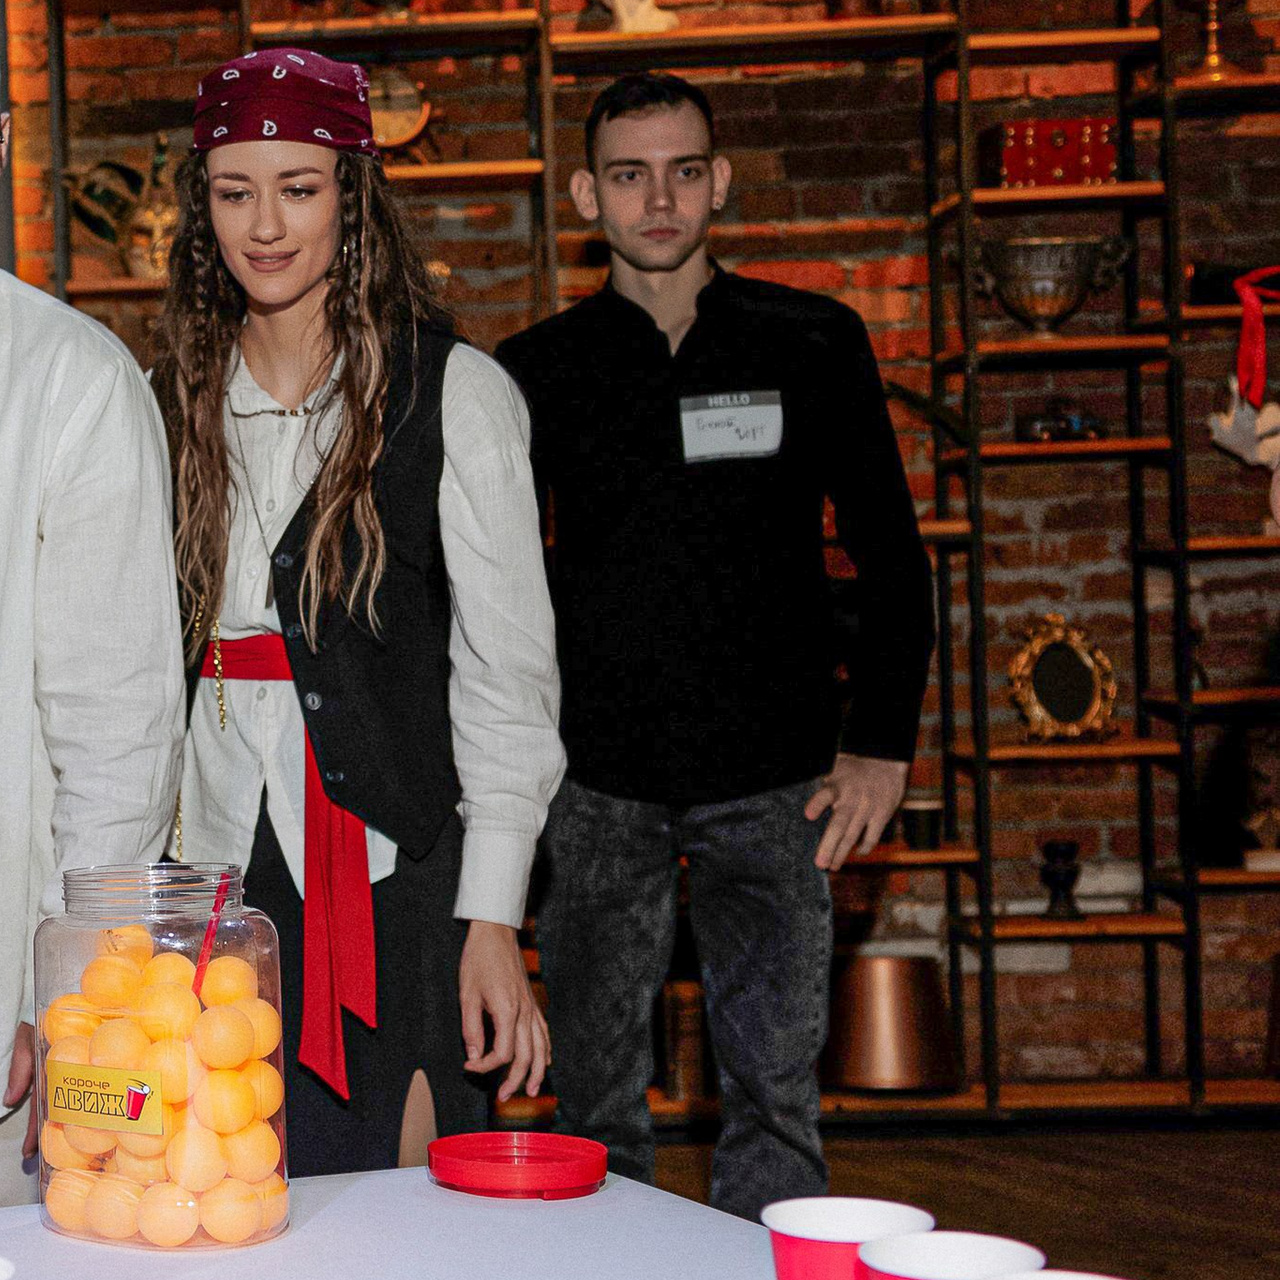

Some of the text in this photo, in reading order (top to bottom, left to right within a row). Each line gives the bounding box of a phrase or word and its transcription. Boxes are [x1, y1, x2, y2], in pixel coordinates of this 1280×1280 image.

[707, 393, 751, 408] HELLO
[62, 1076, 110, 1090] короче
[53, 1086, 126, 1117] АВИЖ
